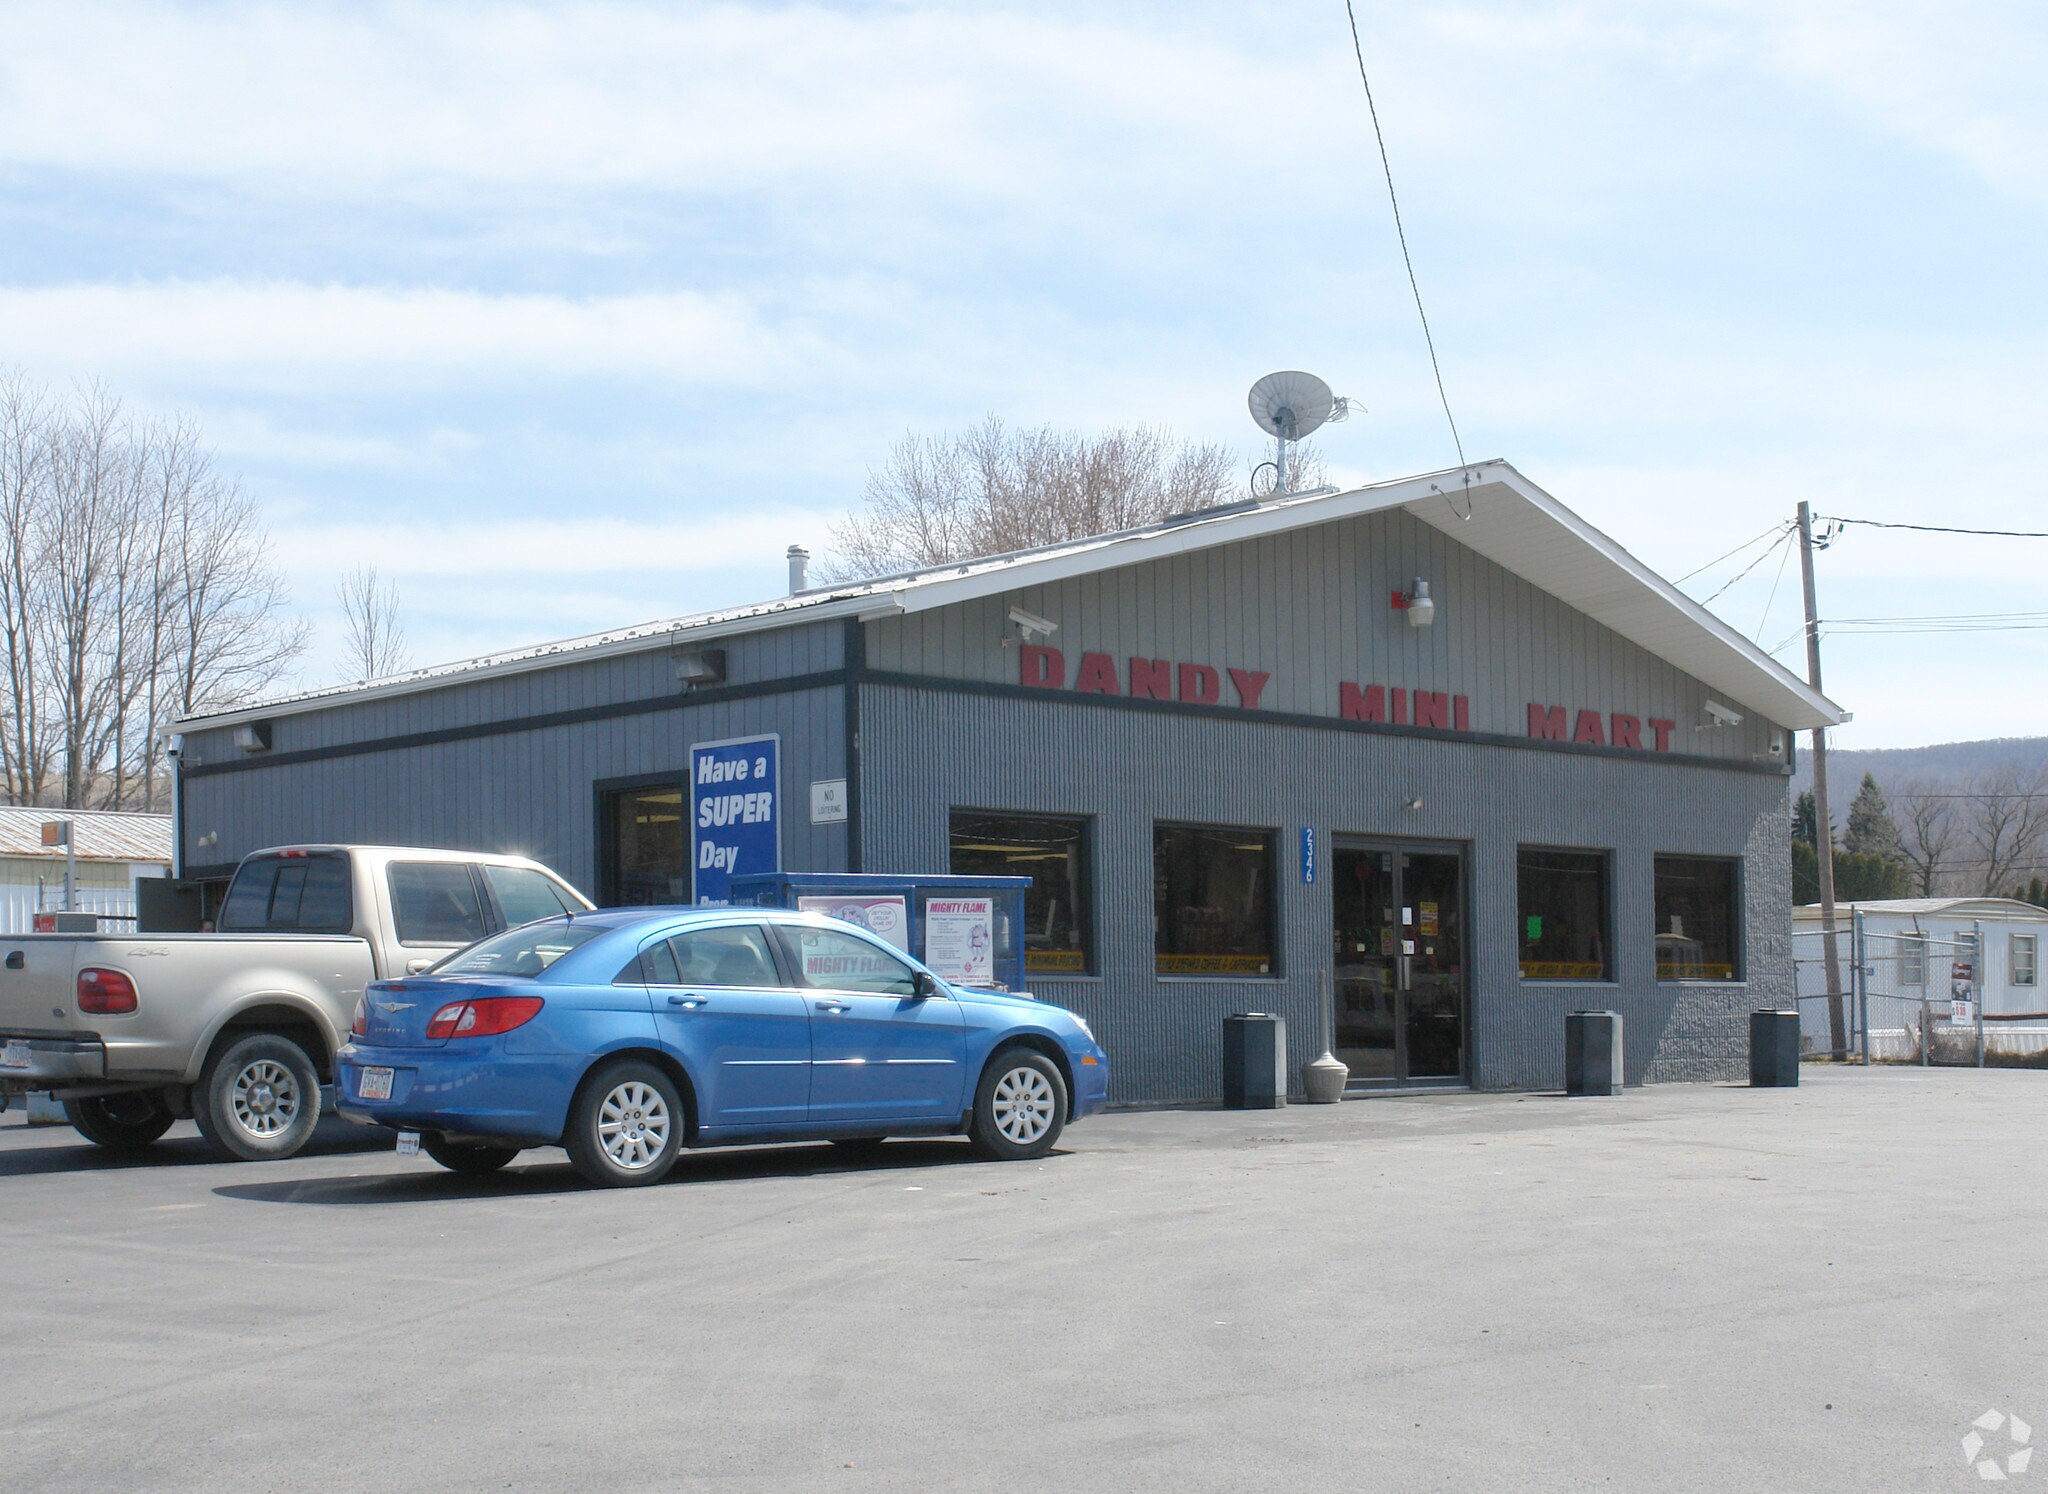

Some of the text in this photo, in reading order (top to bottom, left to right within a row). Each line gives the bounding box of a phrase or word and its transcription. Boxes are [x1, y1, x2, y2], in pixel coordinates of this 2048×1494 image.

[1020, 644, 1676, 754] DANDY MINI MART
[697, 755, 767, 785] Have a
[698, 791, 773, 828] SUPER
[816, 804, 842, 815] LOITERING
[824, 789, 834, 801] NO
[699, 840, 739, 874] Day
[1305, 828, 1314, 883] 2346
[929, 902, 987, 913] MIGHTY FLAME
[807, 956, 858, 975] MIGHTY
